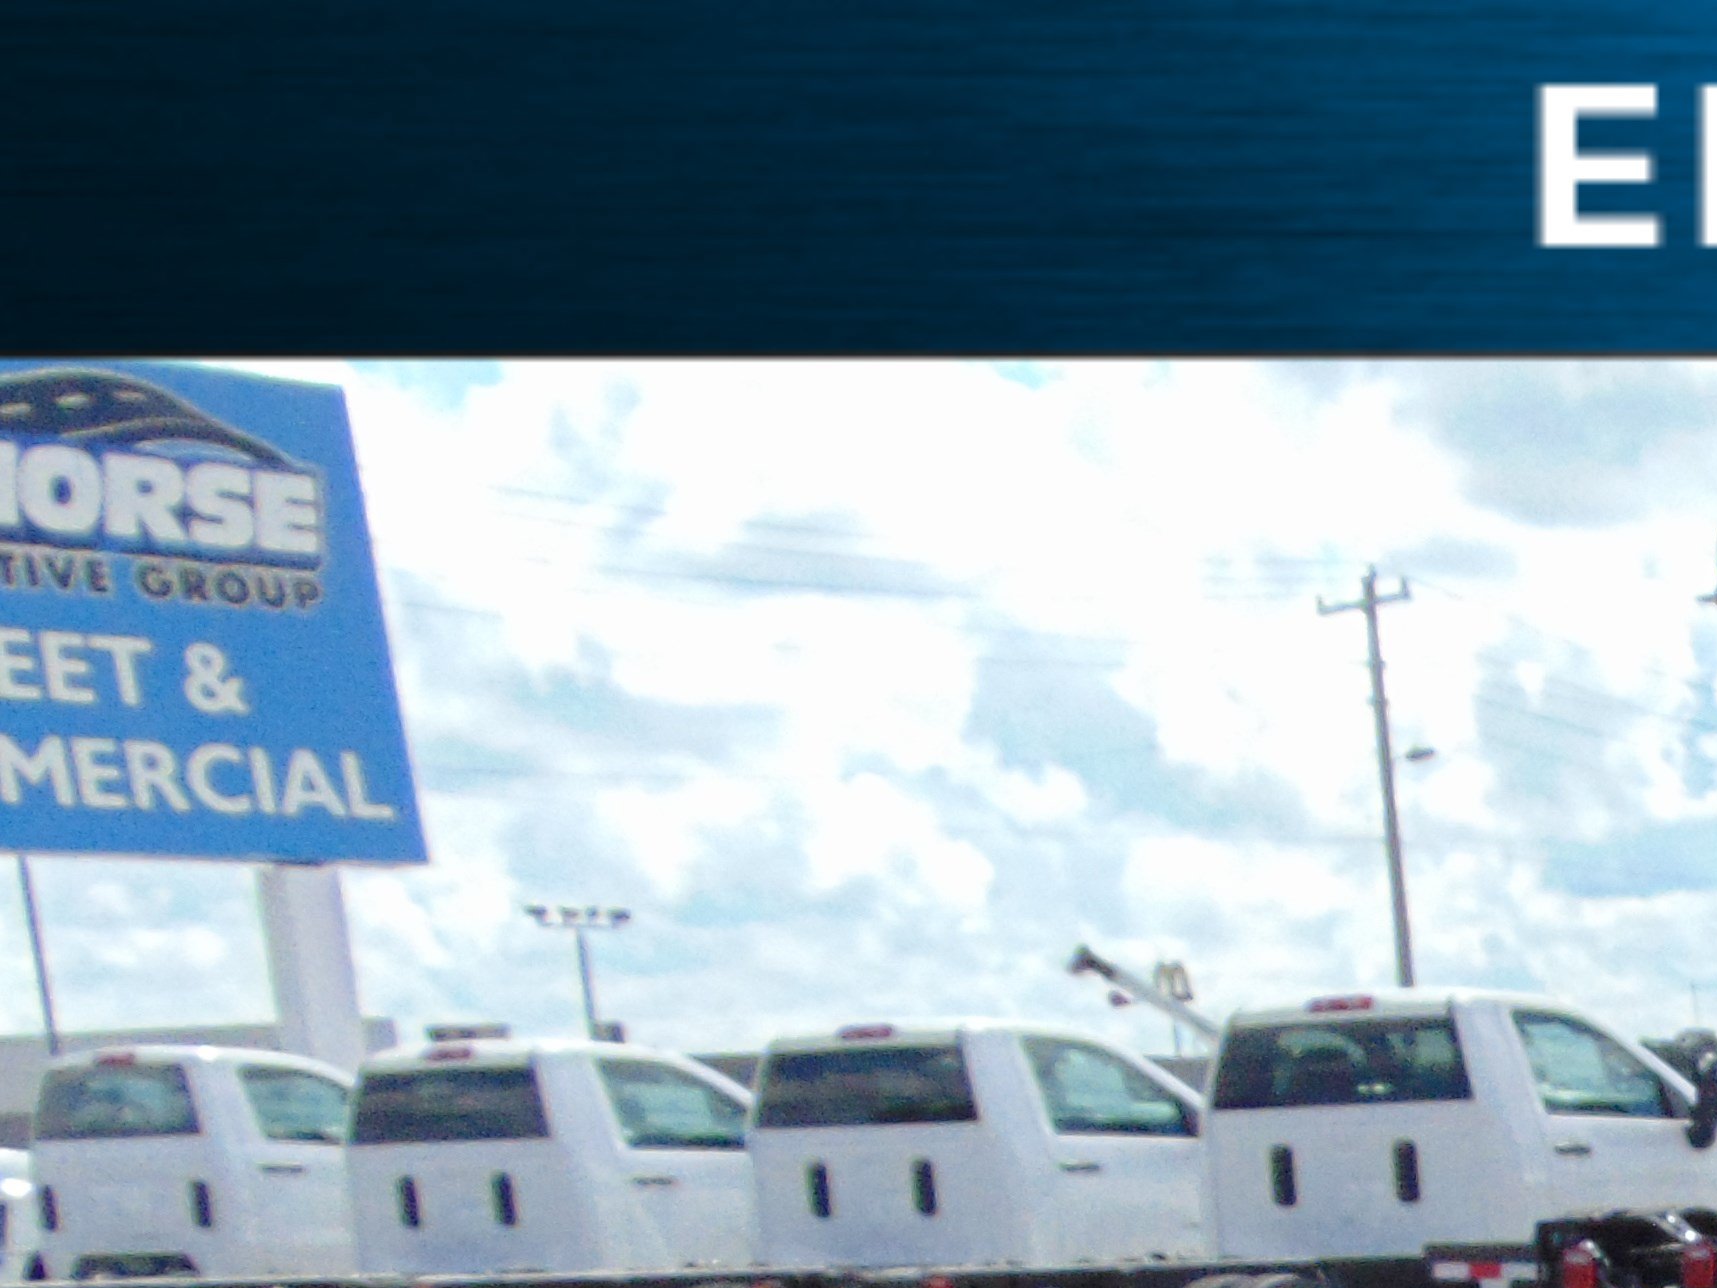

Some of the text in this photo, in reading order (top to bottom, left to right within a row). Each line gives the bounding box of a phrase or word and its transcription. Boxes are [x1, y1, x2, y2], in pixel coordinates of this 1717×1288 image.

[0, 440, 320, 554] ORSE
[137, 562, 321, 609] GROUP
[0, 626, 250, 716] EET &
[0, 733, 395, 821] MERCIAL
